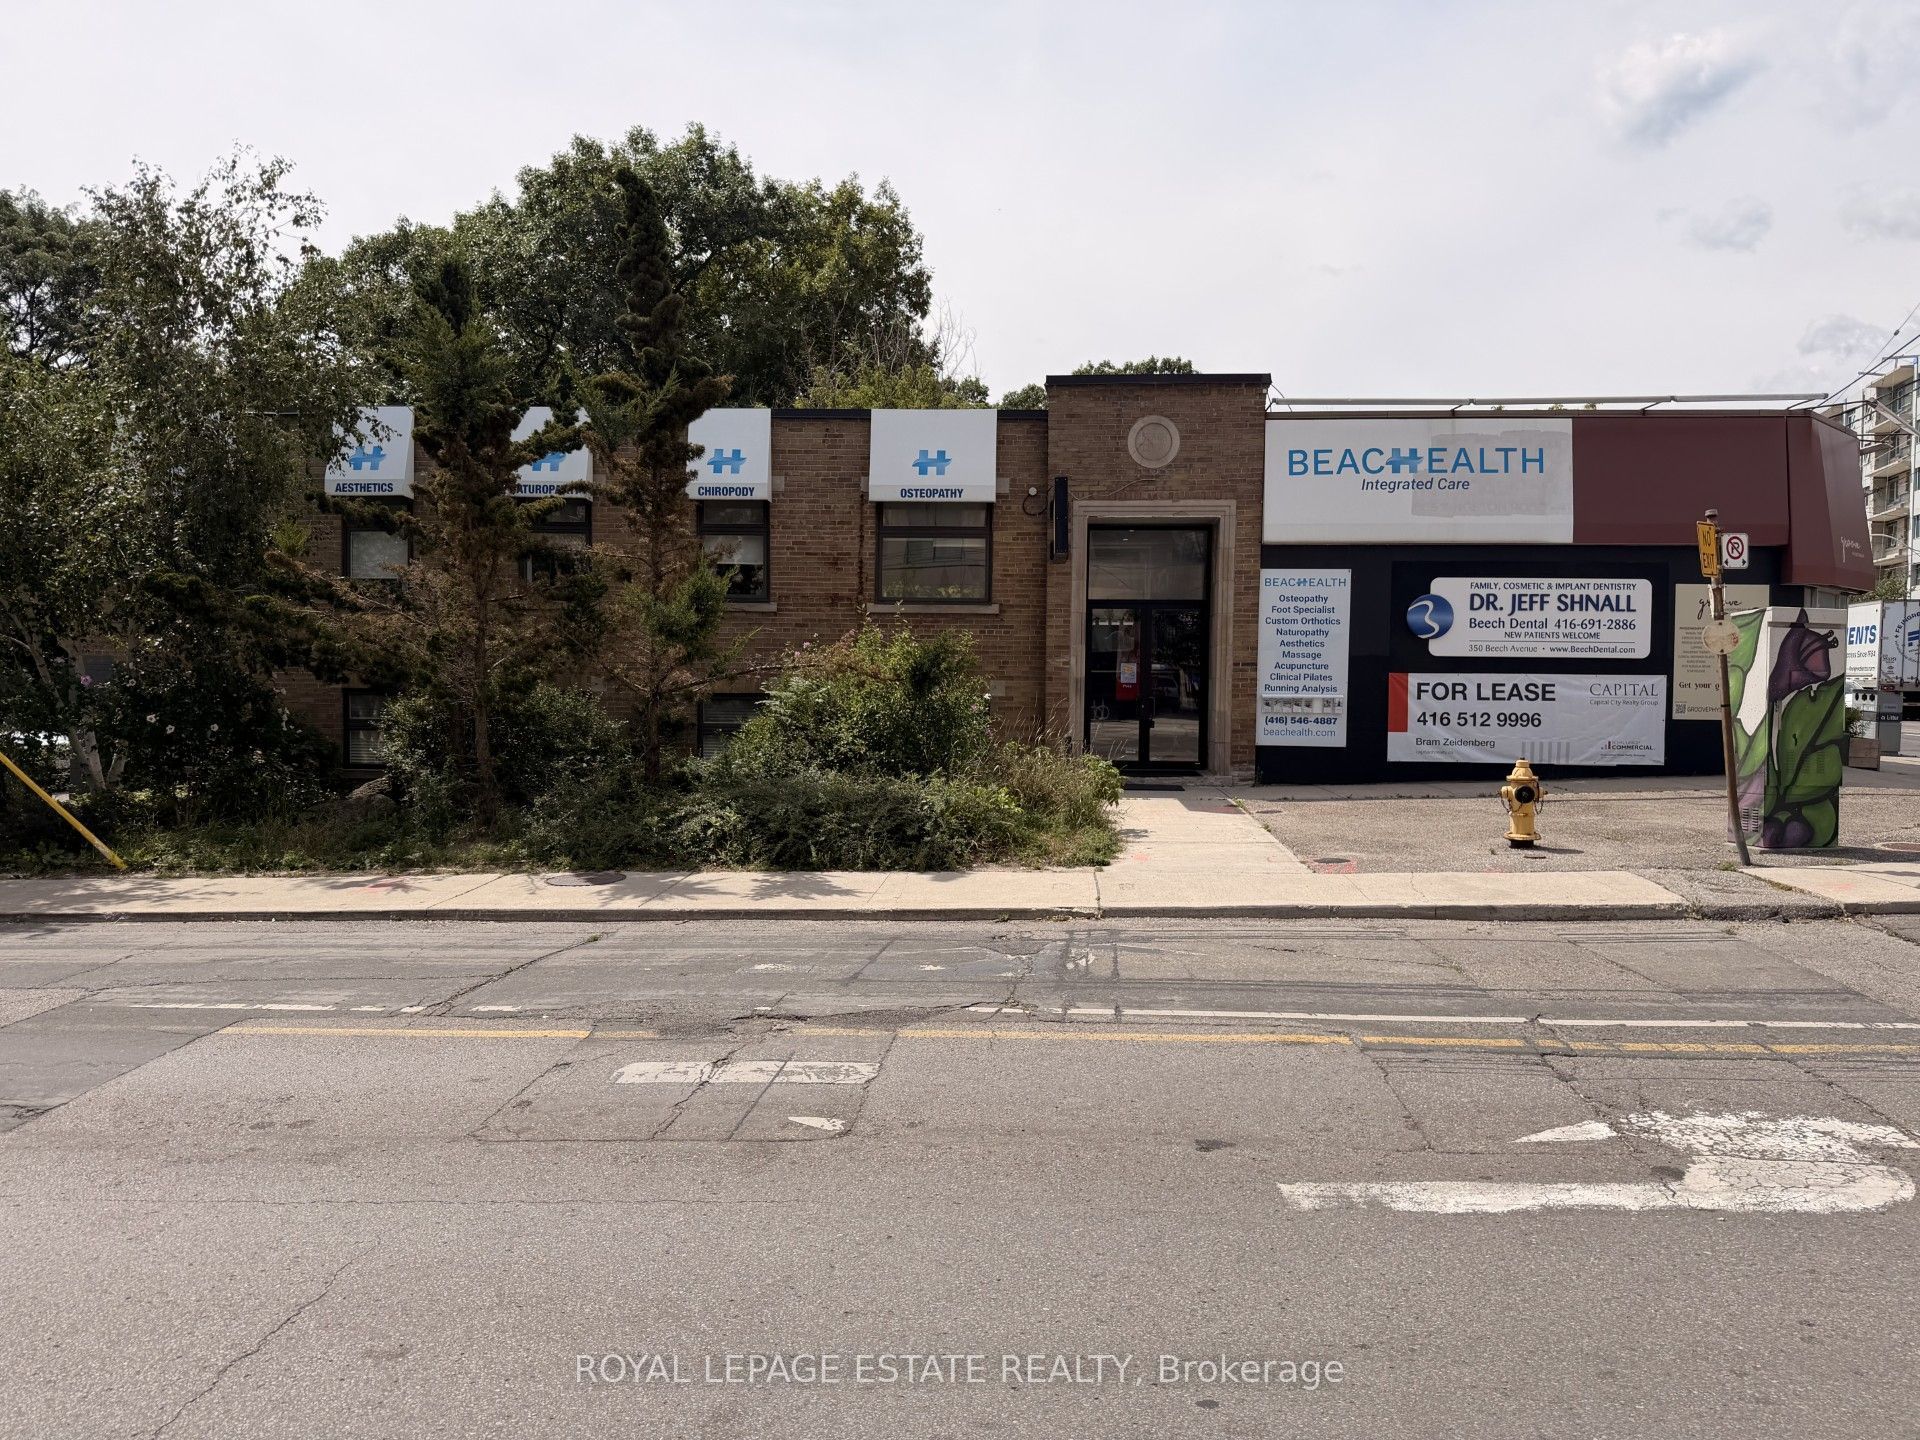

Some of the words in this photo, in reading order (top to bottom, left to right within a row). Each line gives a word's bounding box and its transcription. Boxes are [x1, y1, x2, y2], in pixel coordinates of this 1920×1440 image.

[1288, 447, 1544, 476] BEACHEALTH
[335, 482, 394, 494] AESTHETICS
[1361, 478, 1433, 493] Integrated
[1437, 478, 1470, 491] Care
[697, 486, 755, 497] CHIROPODY
[900, 487, 964, 499] OSTEOPATHY
[1702, 530, 1711, 547] NO
[1702, 552, 1715, 569] EXIT
[1264, 577, 1347, 587] BEACHEALTH
[1470, 582, 1501, 591] FAMILY,
[1503, 582, 1545, 590] COSMETIC
[1546, 582, 1553, 590] &
[1555, 583, 1591, 591] IMPLANT
[1593, 583, 1637, 591] DENTISTRY
[1279, 594, 1329, 604] Osteopathy
[1469, 593, 1503, 611] DR.
[1508, 593, 1550, 616] JEFF
[1556, 593, 1637, 612] SHNALL
[1271, 606, 1291, 614] Foot
[1293, 606, 1335, 615] Specialist
[1265, 617, 1298, 625] Custom
[1301, 617, 1341, 625] Orthotics
[1469, 617, 1505, 629] Beech
[1510, 617, 1548, 629] Dental
[1554, 618, 1636, 630] 416-691-2886
[1276, 628, 1329, 638] Naturopathy
[1504, 631, 1522, 639] NEW
[1524, 631, 1561, 639] PATIENTS
[1562, 631, 1600, 640] WELCOME
[1847, 624, 1877, 645] ENTS
[1279, 639, 1325, 647] Aesthetics
[1468, 644, 1483, 652] 350
[1485, 644, 1508, 653] Beech
[1509, 644, 1538, 653] Avenue
[1549, 645, 1636, 654] www.BeechDental.com
[1282, 651, 1322, 660] Massage
[1274, 662, 1329, 672] Acupuncture
[1270, 673, 1301, 681] Clinical
[1303, 673, 1333, 682] Pilates
[1264, 684, 1299, 694] Running
[1301, 684, 1338, 695] Analysis
[1589, 683, 1659, 697] CAPITAL
[1678, 681, 1691, 689] Get
[1694, 682, 1712, 691] your
[1416, 682, 1467, 701] FOR
[1476, 682, 1556, 702] LEASE
[1264, 716, 1288, 726] (416)
[1416, 711, 1451, 727] 416
[1457, 712, 1491, 727] 512
[1496, 712, 1542, 728] 9996
[1263, 727, 1336, 738] beachealth.com
[1415, 737, 1440, 746] Bram
[1443, 738, 1496, 748] Zeidenberg
